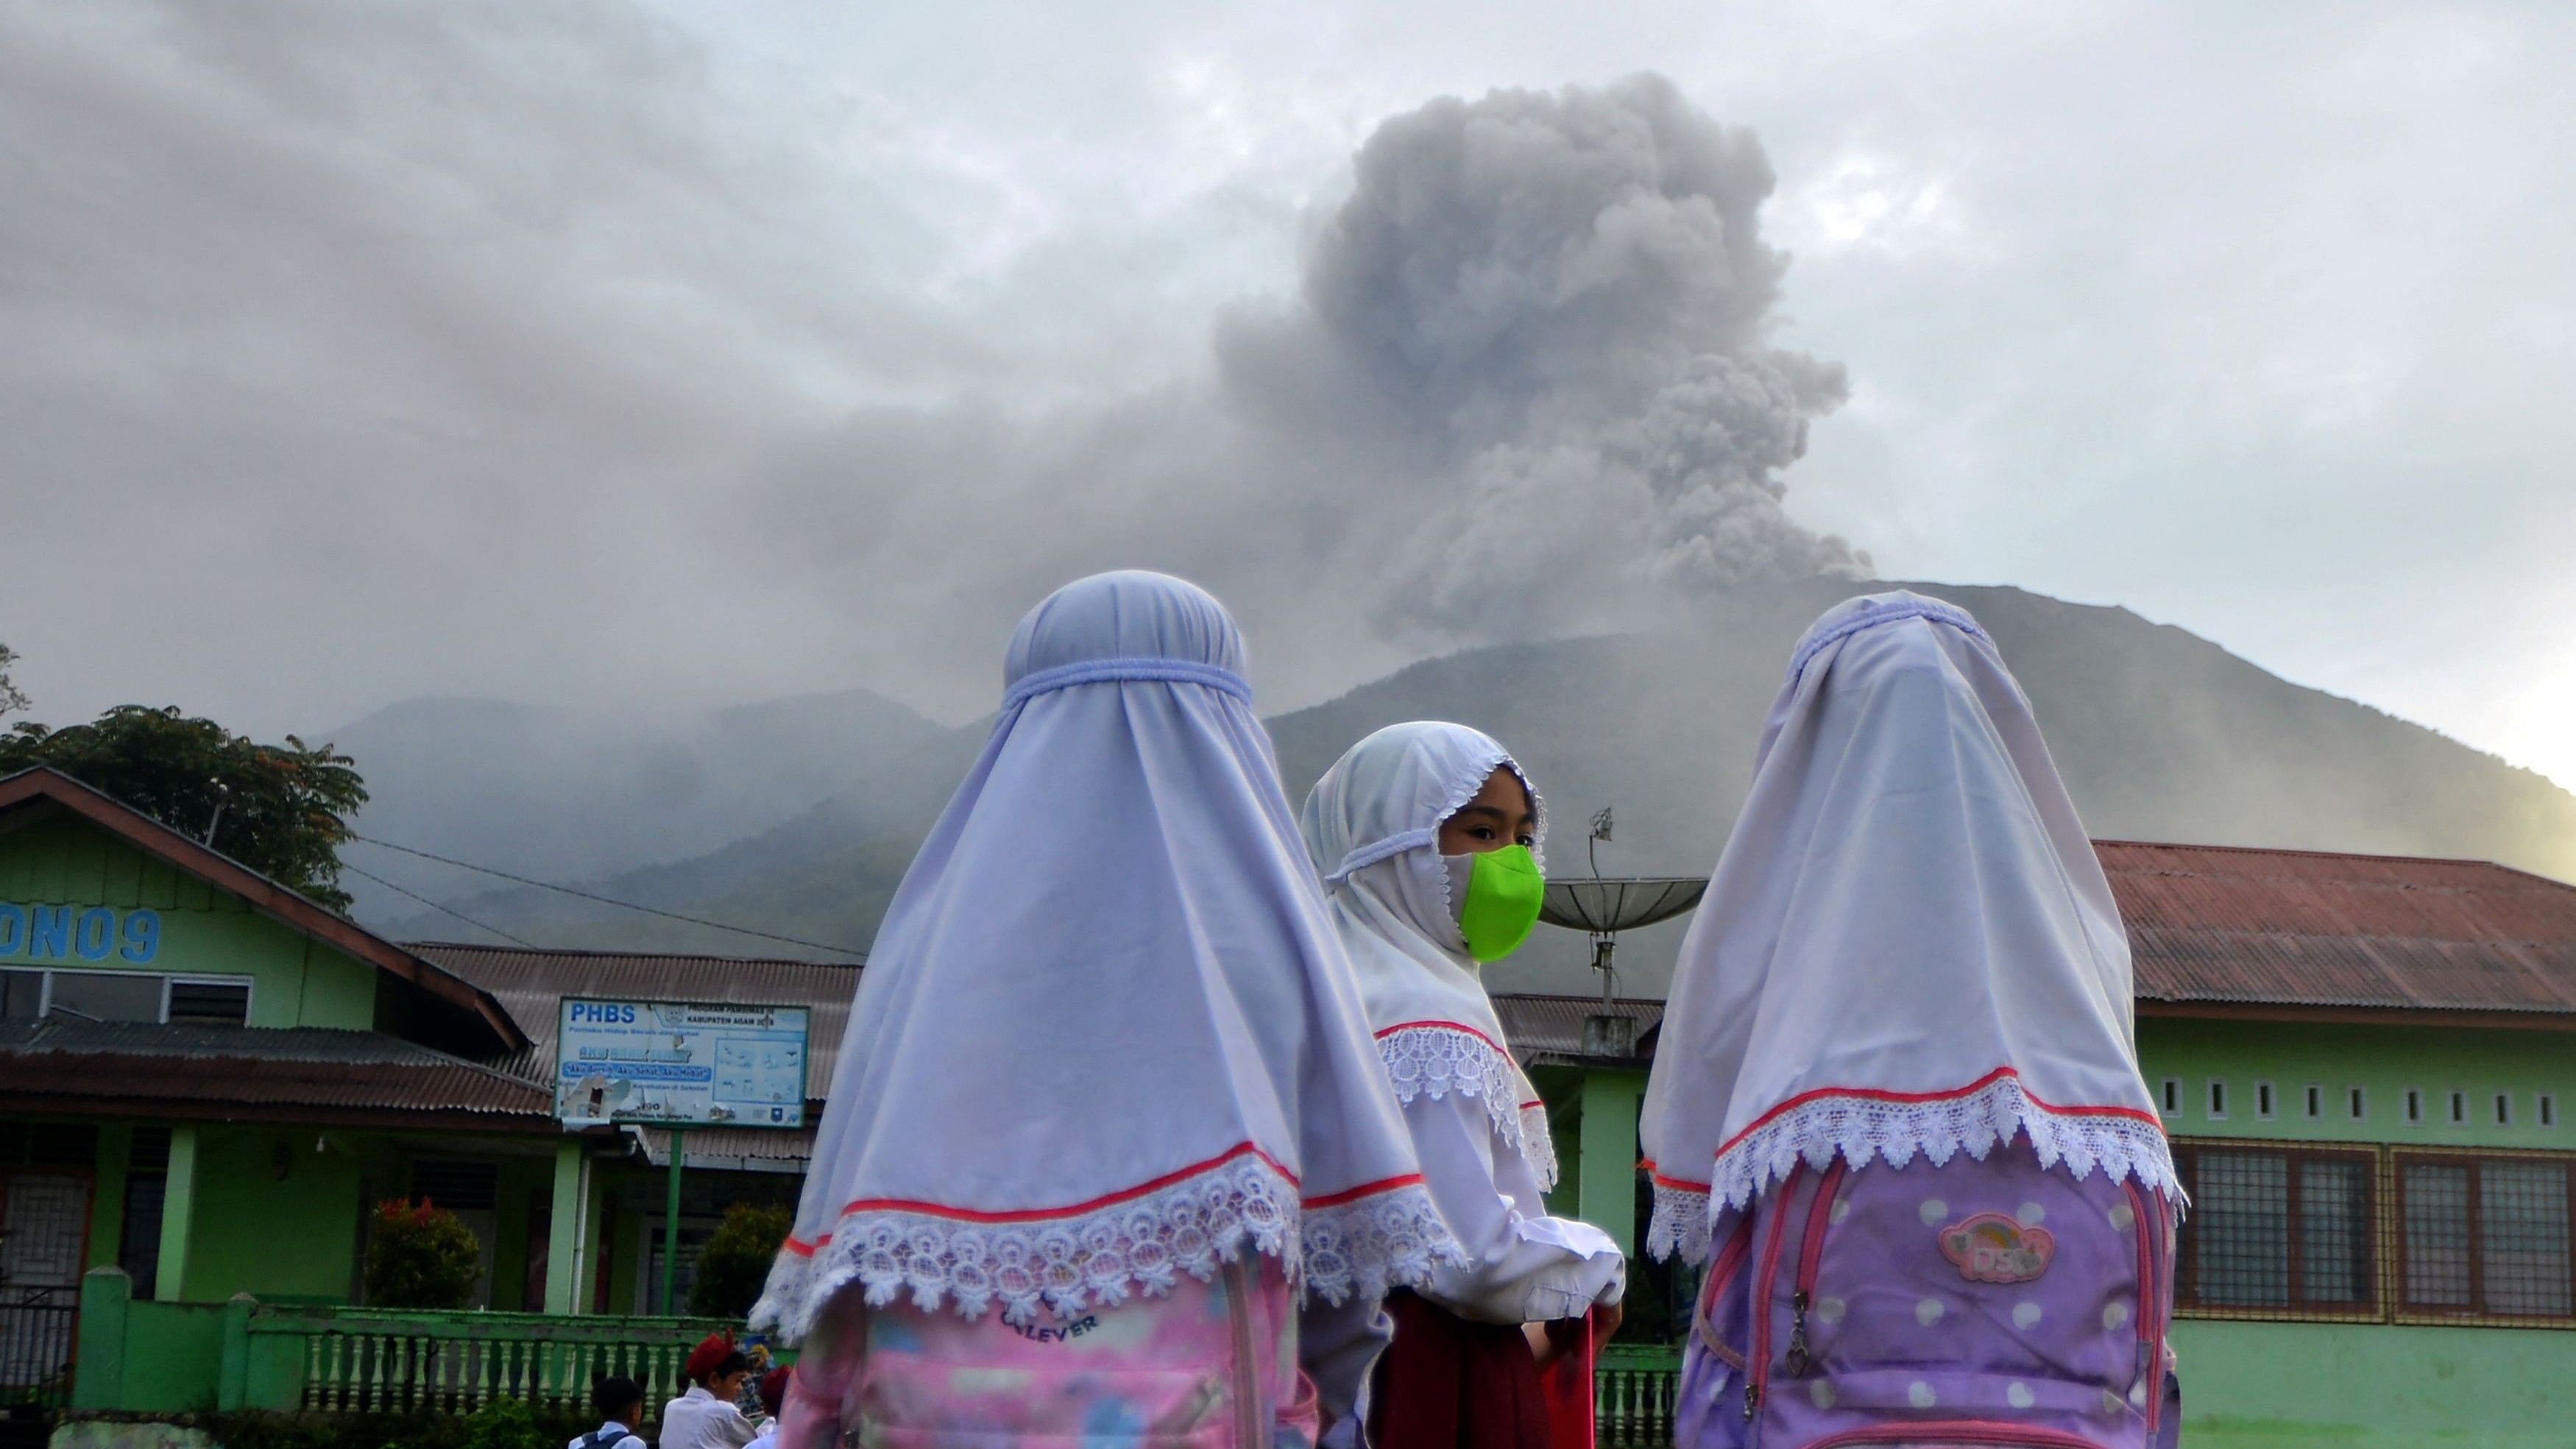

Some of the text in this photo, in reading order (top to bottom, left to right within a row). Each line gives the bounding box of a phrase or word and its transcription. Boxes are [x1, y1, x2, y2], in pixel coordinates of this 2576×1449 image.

[570, 1003, 635, 1024] PHBS
[687, 1017, 732, 1025] KABUPATEN
[734, 1018, 754, 1026] AGAM
